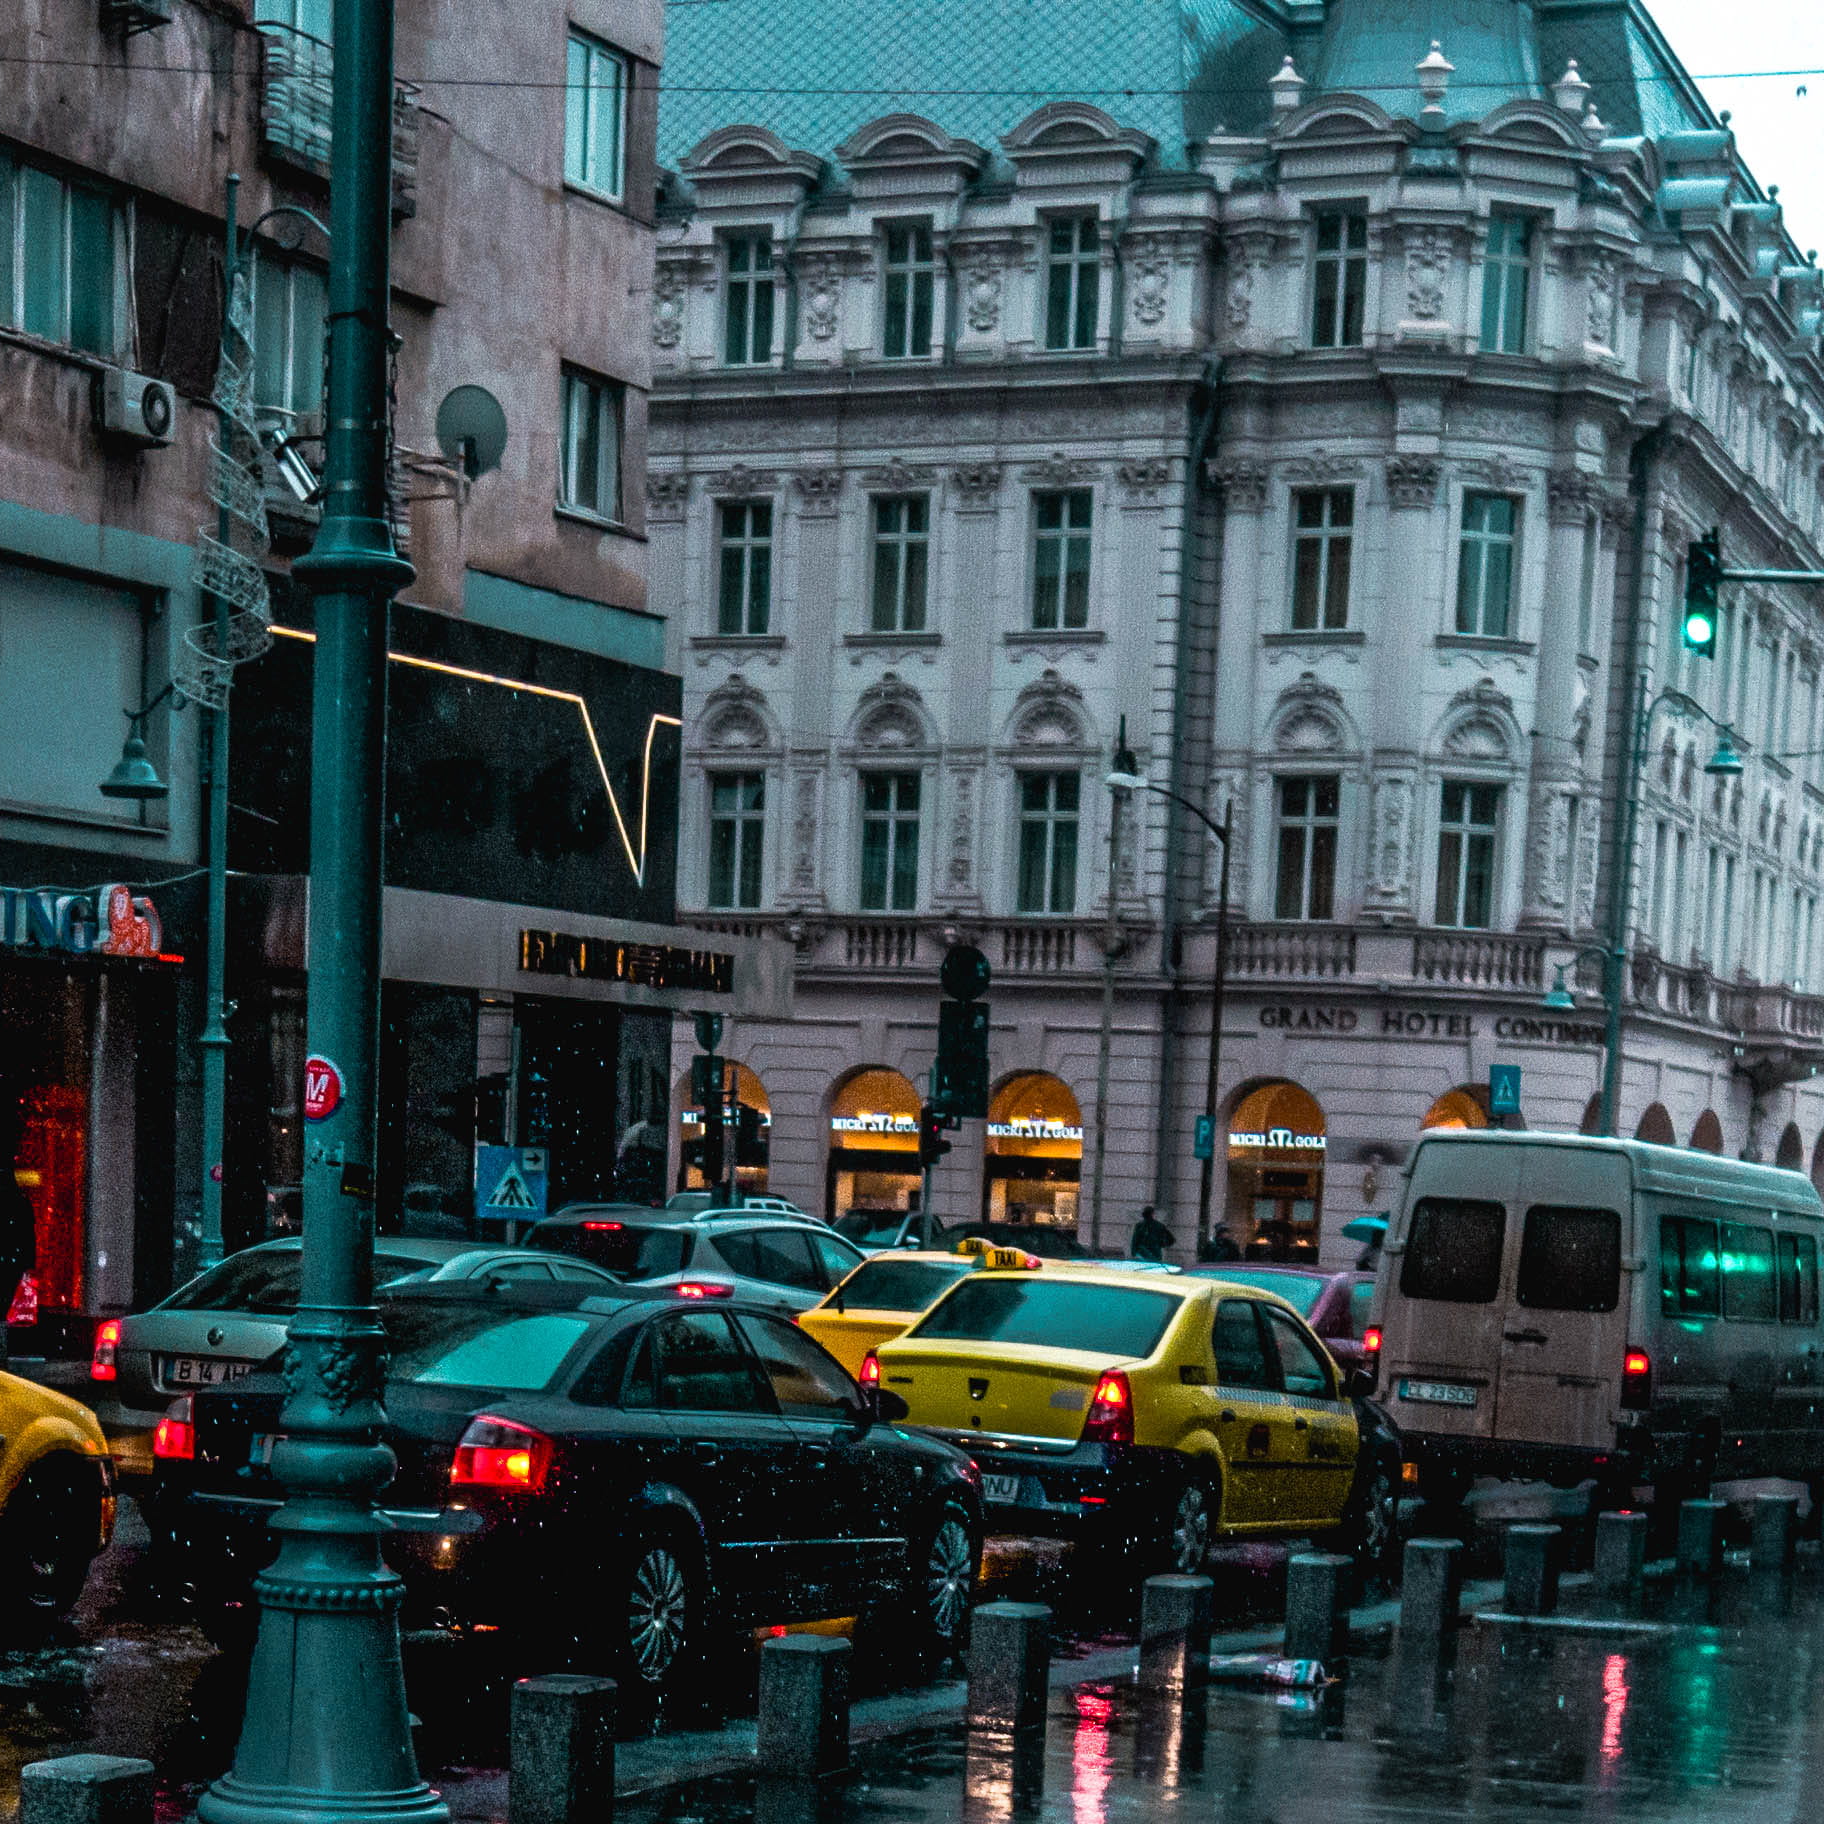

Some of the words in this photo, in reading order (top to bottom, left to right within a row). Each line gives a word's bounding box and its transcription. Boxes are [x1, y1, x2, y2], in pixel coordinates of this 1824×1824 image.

[1259, 1005, 1358, 1033] GRAND
[1382, 1011, 1476, 1038] HOTEL
[994, 1250, 1017, 1266] TAXI
[179, 1361, 191, 1380] B
[199, 1363, 213, 1382] 14
